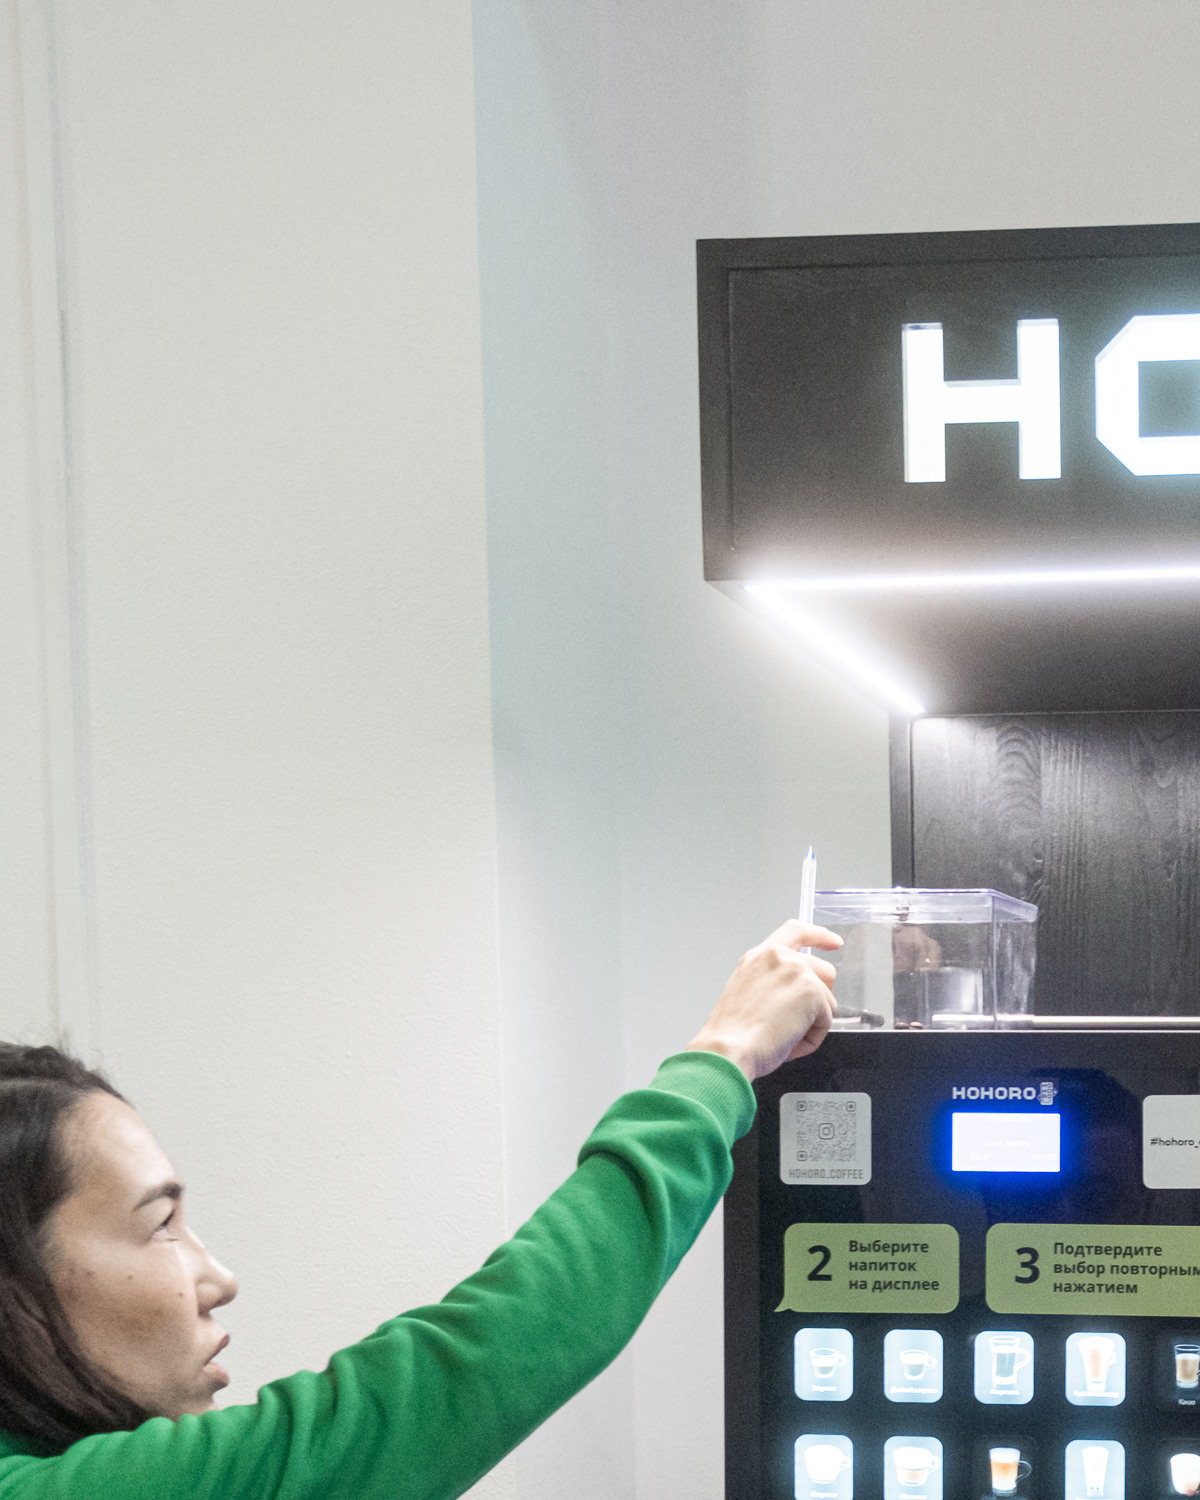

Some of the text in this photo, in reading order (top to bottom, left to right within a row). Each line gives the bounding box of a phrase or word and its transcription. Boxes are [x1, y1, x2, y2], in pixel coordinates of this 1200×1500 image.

[952, 1086, 1037, 1100] HOHORO
[848, 1240, 929, 1256] Выберите
[1053, 1242, 1163, 1259] Подтвердите
[807, 1244, 833, 1282] 2
[848, 1261, 918, 1272] напиток
[1014, 1246, 1041, 1284] 3
[1053, 1261, 1106, 1278] выбор
[848, 1280, 940, 1293] на дисплее
[1053, 1281, 1139, 1294] нажатием
